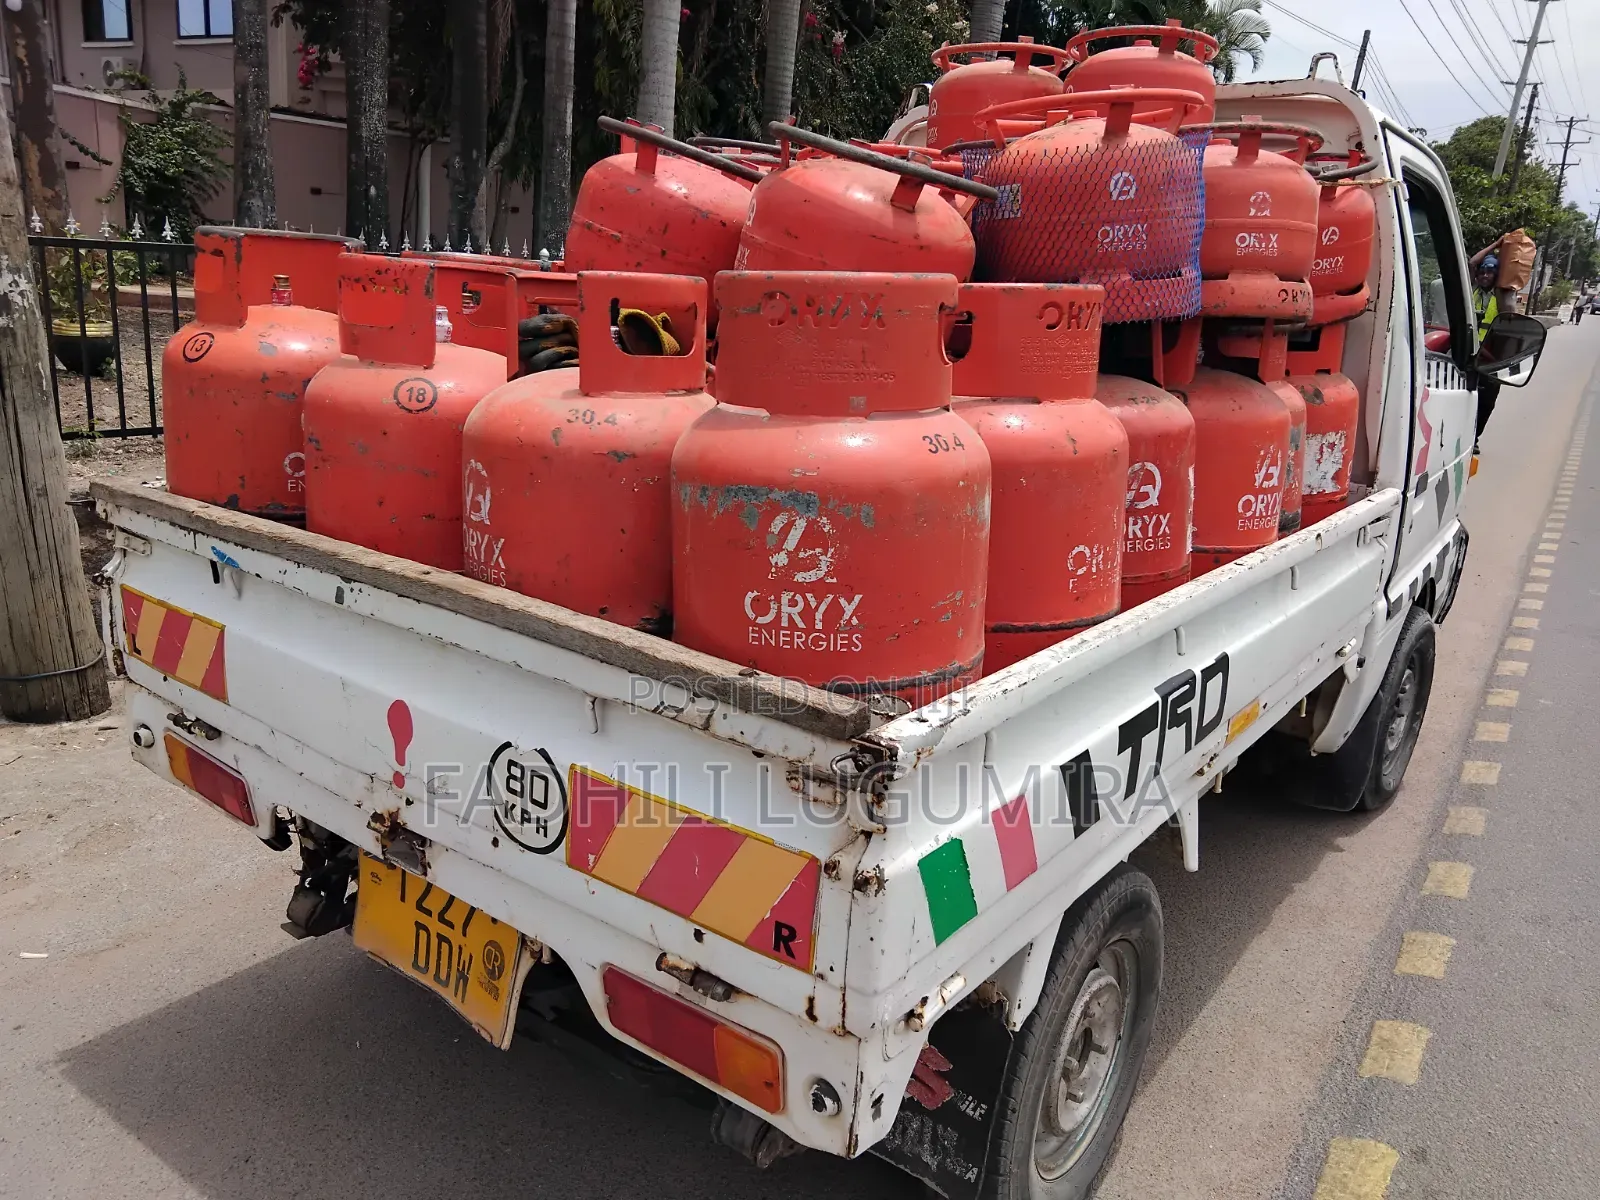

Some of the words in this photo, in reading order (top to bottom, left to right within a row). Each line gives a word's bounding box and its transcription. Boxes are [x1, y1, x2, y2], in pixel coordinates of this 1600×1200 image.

[1097, 223, 1148, 243] ORYX
[1235, 232, 1279, 248] ORYX
[1312, 256, 1345, 270] ORYX
[760, 290, 888, 330] ORYX
[190, 338, 206, 352] 13
[405, 386, 427, 404] 18
[566, 408, 618, 427] 30.4
[921, 434, 966, 455] 30.4
[1123, 513, 1171, 539] RYX
[1237, 515, 1280, 531] ENERGIE
[1121, 537, 1171, 553] ERGIES
[744, 590, 863, 630] ORYX
[748, 626, 863, 652] ENERGIES
[1117, 651, 1230, 801] TRD
[505, 758, 550, 811] 80
[504, 799, 549, 838] KPH
[772, 920, 798, 960] R
[411, 919, 474, 1004] DDW
